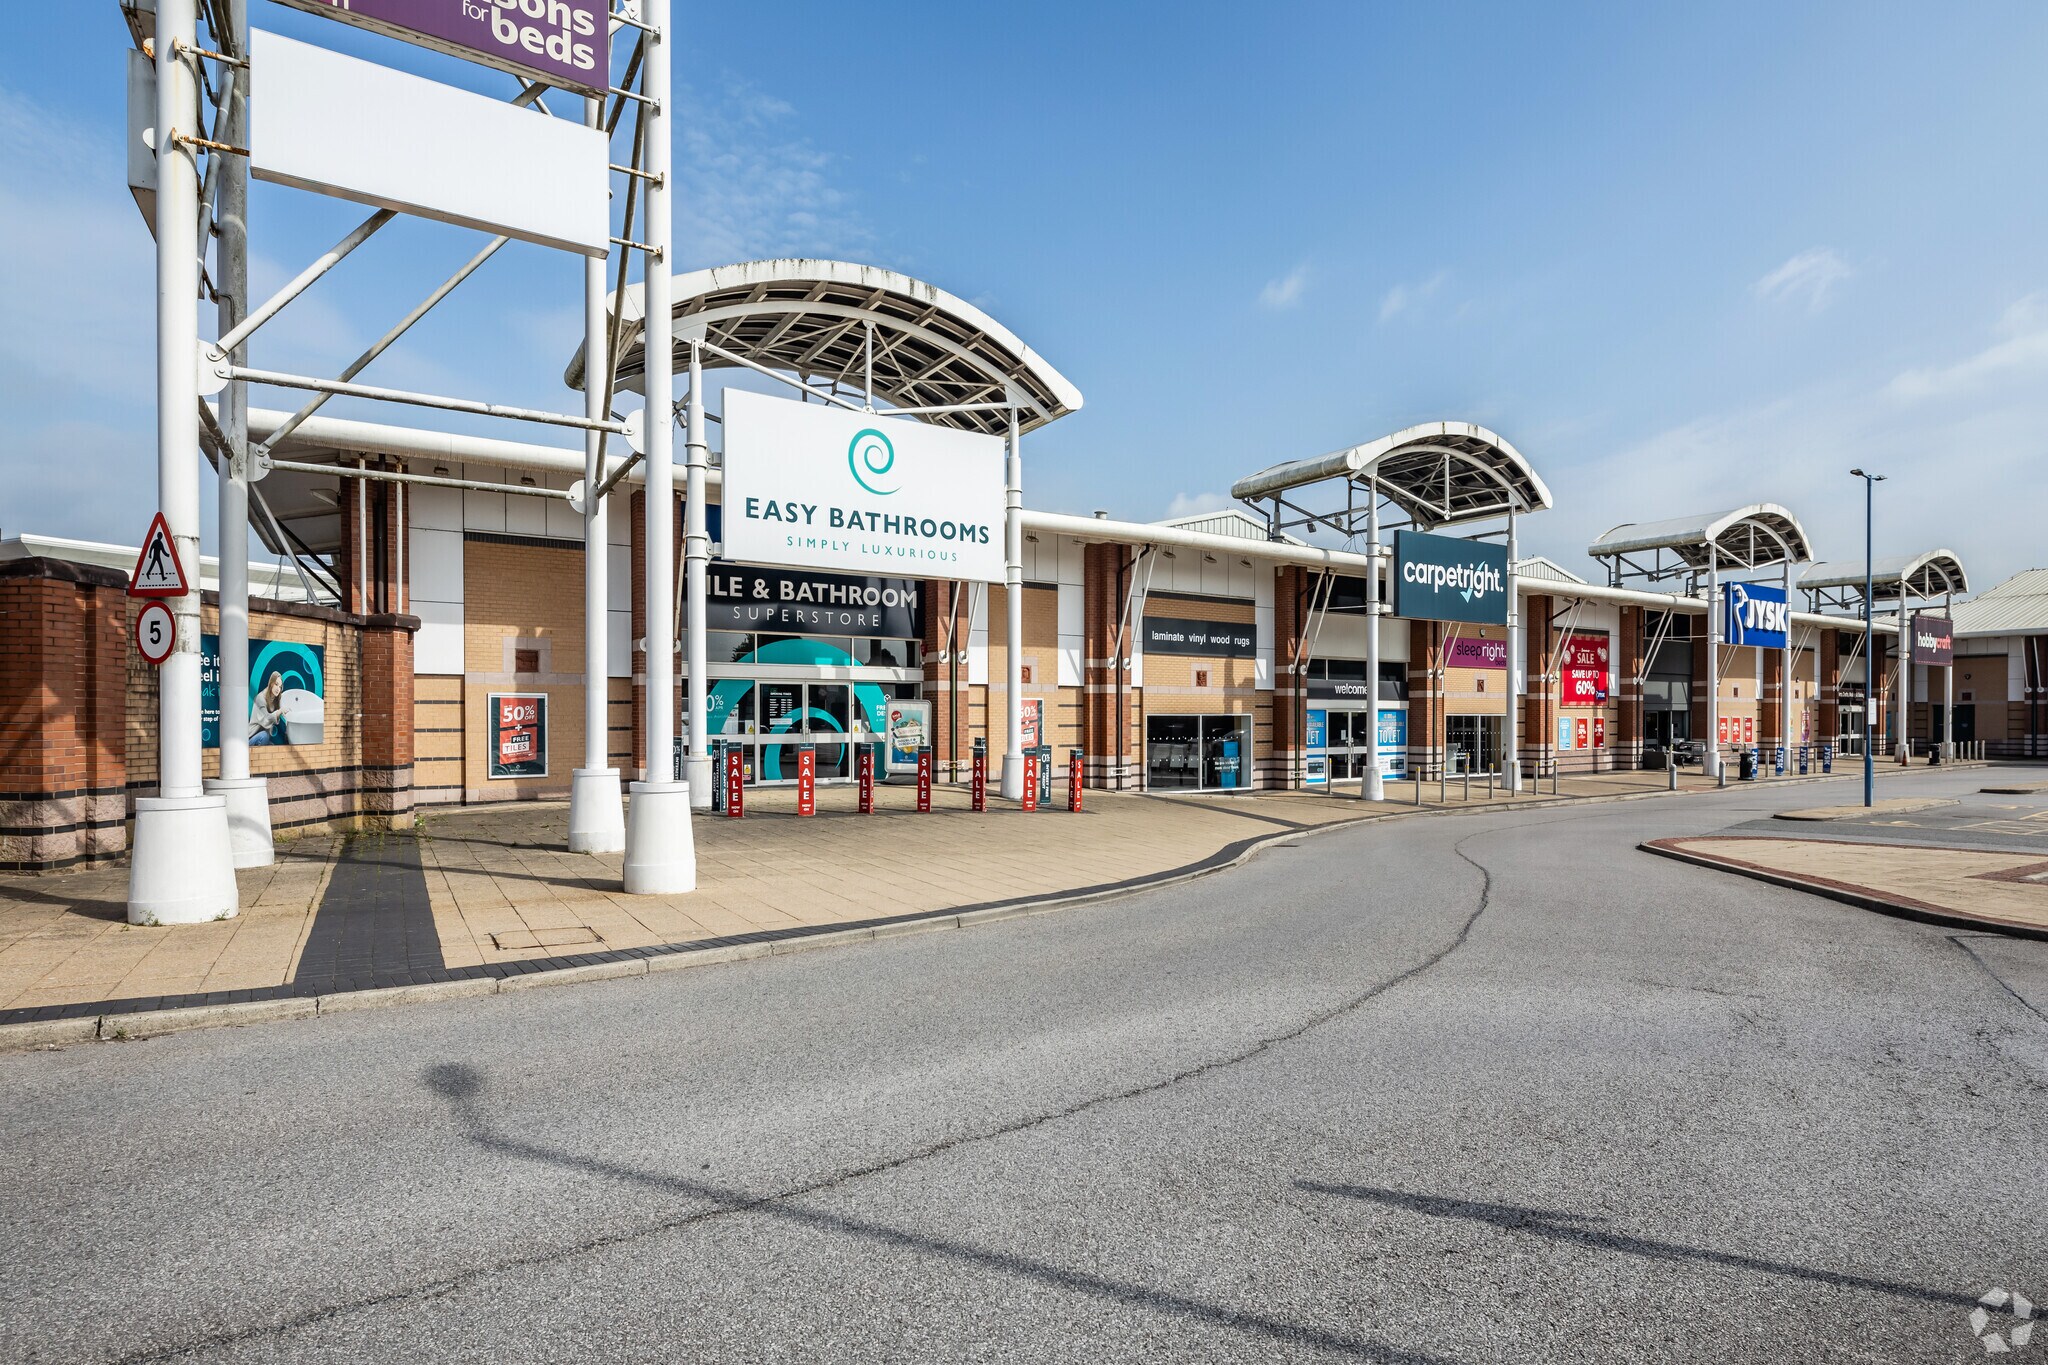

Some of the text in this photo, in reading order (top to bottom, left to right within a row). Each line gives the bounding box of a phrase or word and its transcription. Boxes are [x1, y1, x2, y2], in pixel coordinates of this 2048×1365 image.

[463, 0, 489, 21] for
[491, 6, 595, 69] beds
[745, 497, 990, 544] EASY BATHROOMS
[787, 536, 957, 562] SIMPLY LUXURIOUS
[705, 574, 918, 609] ILE & BATHROOM
[733, 606, 880, 627] SUPERSTORE
[1744, 599, 1787, 632] JYSK
[149, 620, 162, 645] 5
[1151, 630, 1250, 647] laminate vinyl wood rugs
[1917, 631, 1951, 653] hobbycraft
[1577, 653, 1594, 664] SALE
[1571, 669, 1600, 679] SAVE UP TO
[1334, 682, 1367, 695] welcome
[1575, 681, 1596, 695] 60%
[1379, 730, 1400, 743] TO LET
[504, 743, 528, 752] TILES
[731, 756, 740, 802] SALE
[802, 756, 811, 800] SALE
